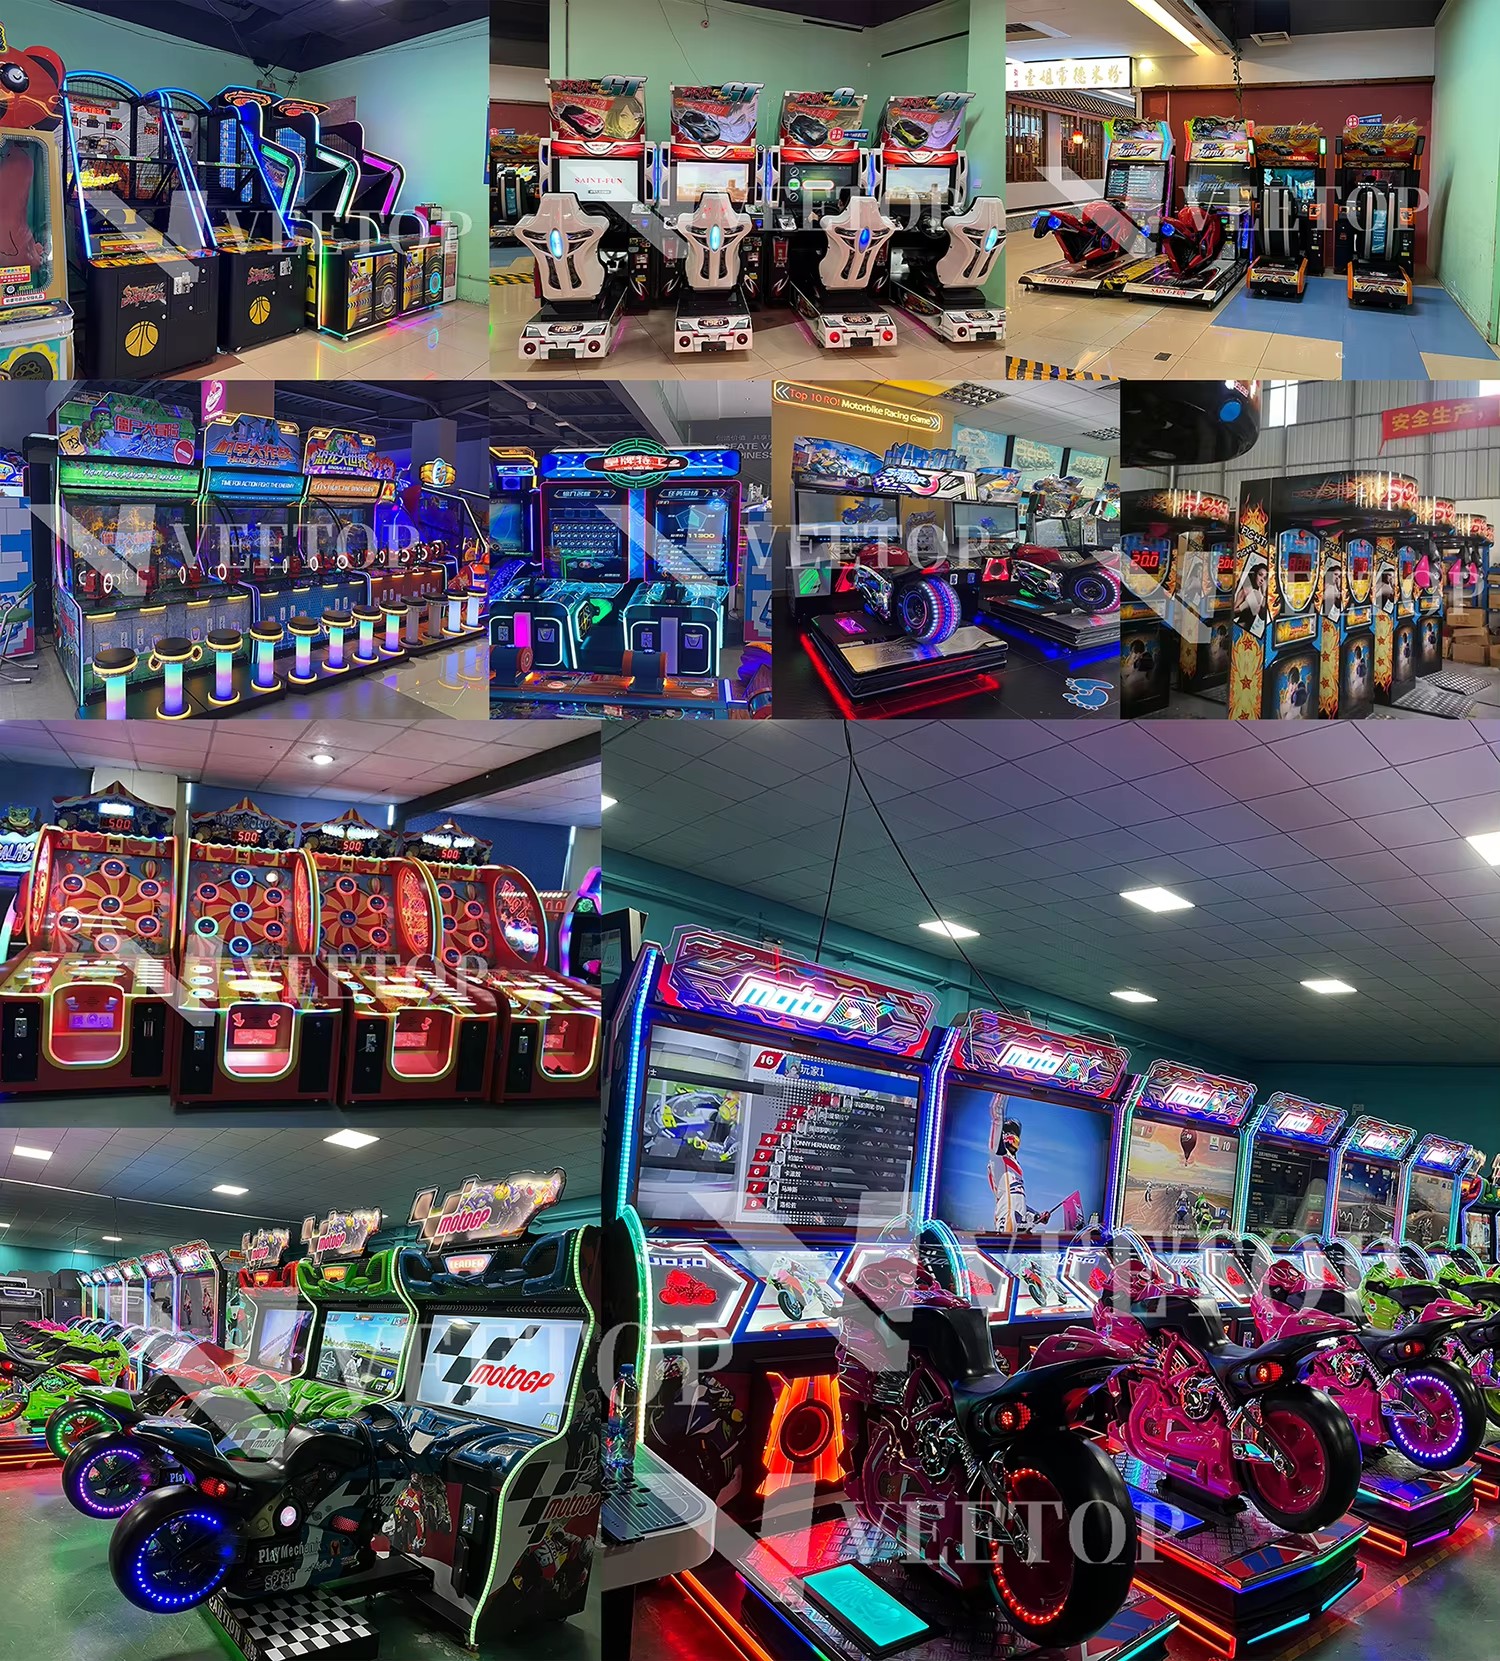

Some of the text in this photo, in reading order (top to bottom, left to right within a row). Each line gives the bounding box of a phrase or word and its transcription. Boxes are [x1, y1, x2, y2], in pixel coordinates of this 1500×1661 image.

[574, 176, 623, 184] SAINT-FUN
[789, 388, 808, 401] Top
[811, 392, 822, 402] 10
[841, 399, 884, 415] Motorbike
[884, 408, 909, 422] Racing
[910, 414, 931, 425] Game
[108, 818, 131, 830] 500
[238, 830, 258, 842] 500
[343, 840, 361, 851] 500
[441, 850, 459, 860] 500
[760, 1054, 774, 1064] 16
[437, 1207, 492, 1236] motoGP
[450, 1258, 485, 1270] LEADER
[551, 1305, 580, 1314] CAMERA
[468, 1363, 556, 1394] motoGP
[543, 1491, 602, 1520] motoGP
[208, 1596, 242, 1643] CAUTION
